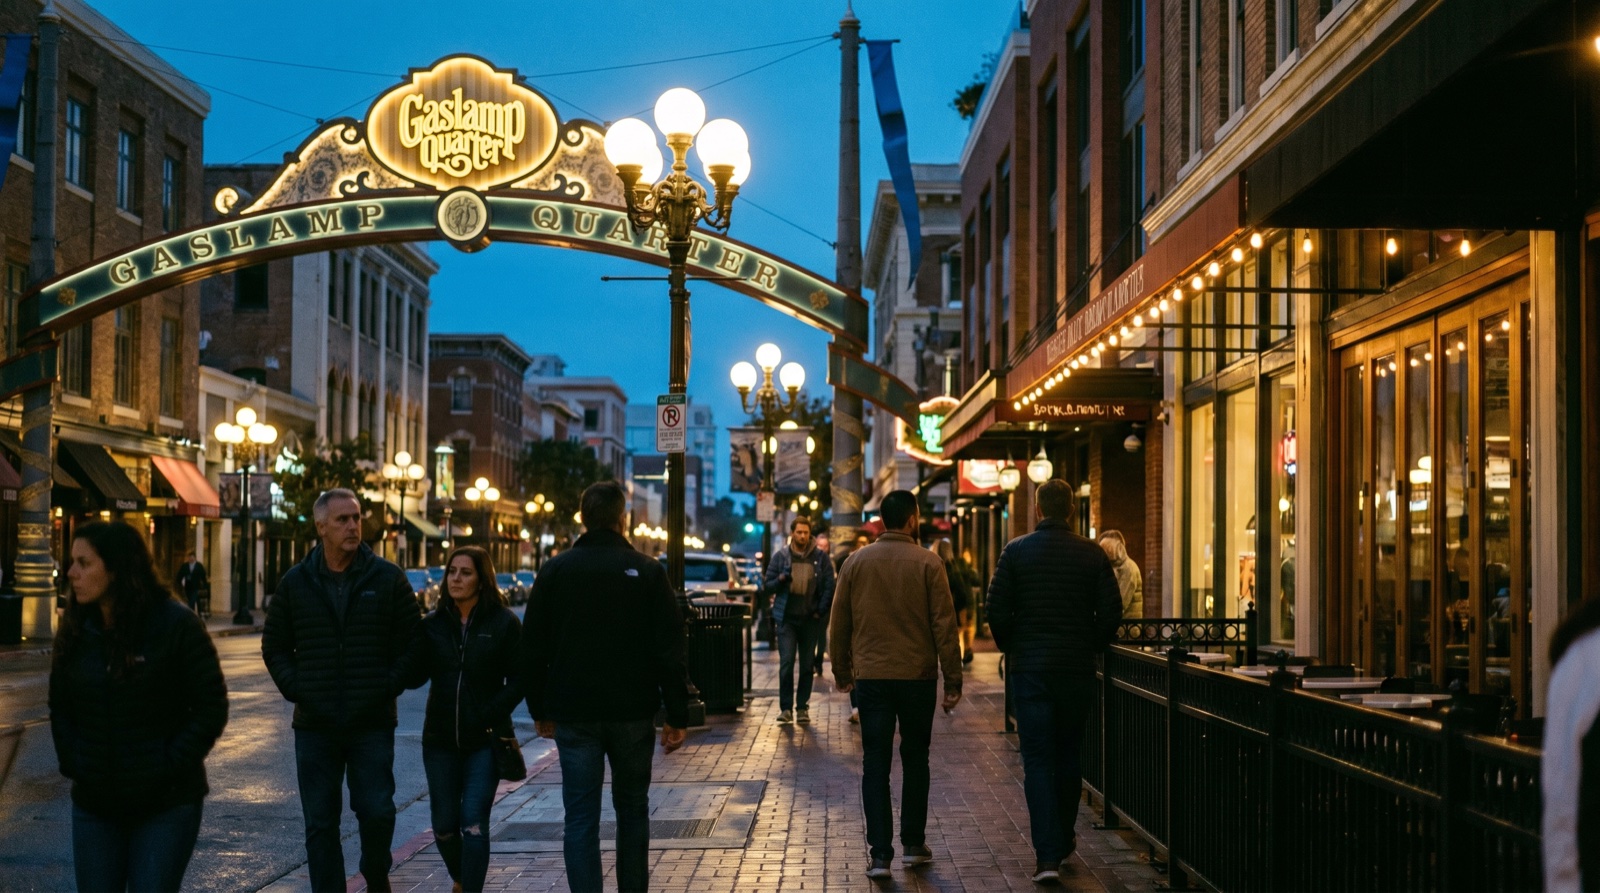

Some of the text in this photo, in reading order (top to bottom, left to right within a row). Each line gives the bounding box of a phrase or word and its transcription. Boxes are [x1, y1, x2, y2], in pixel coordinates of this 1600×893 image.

[398, 87, 526, 161] Gaslamp
[420, 130, 504, 178] Quarter
[109, 203, 780, 290] GASLAMP QUARTER
